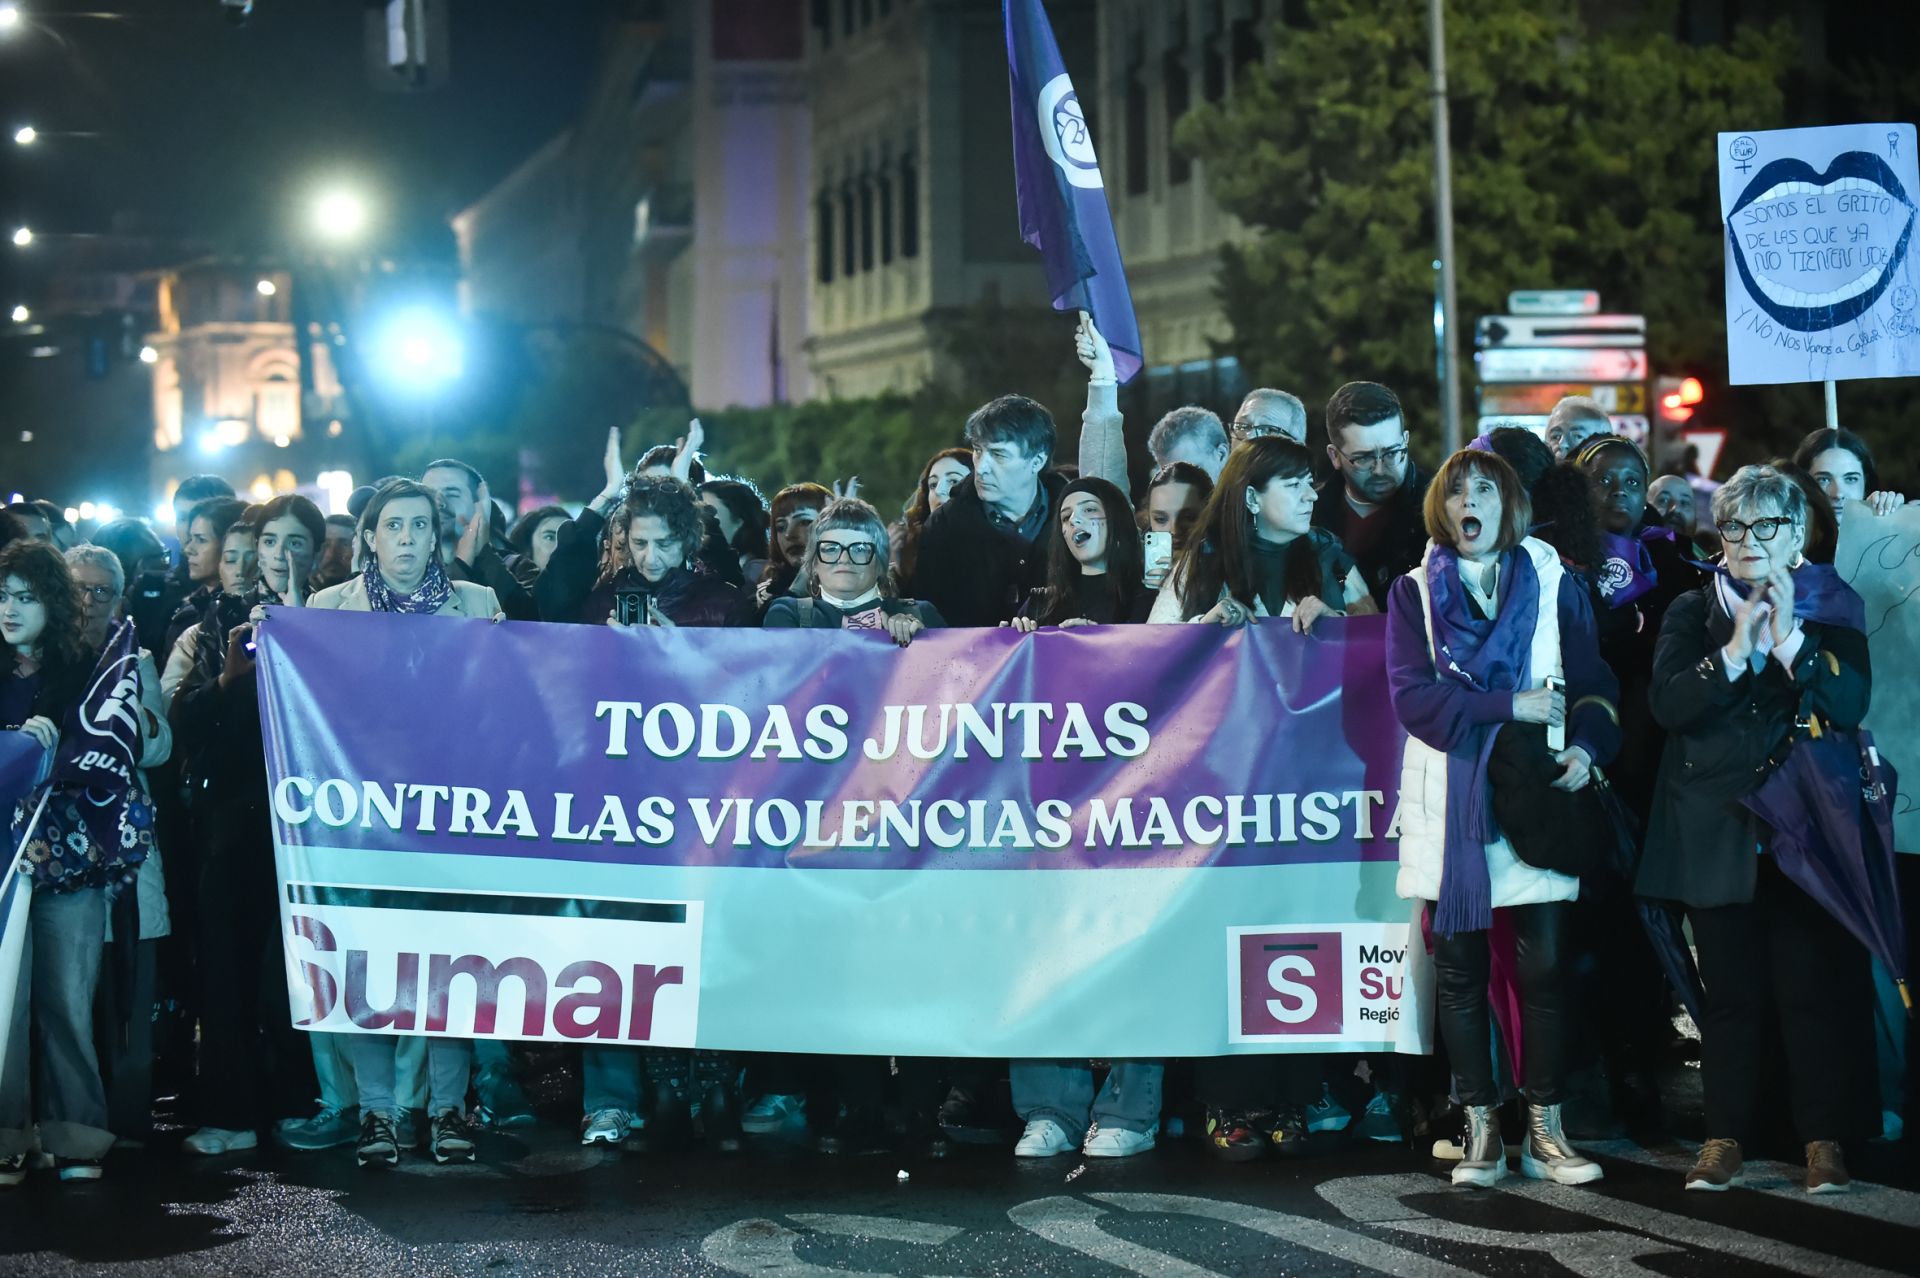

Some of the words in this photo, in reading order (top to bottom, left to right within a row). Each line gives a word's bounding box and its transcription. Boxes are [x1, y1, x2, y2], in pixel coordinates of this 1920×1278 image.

[1744, 201, 1798, 226] SOMOS
[1806, 197, 1826, 214] EL
[1838, 194, 1890, 215] GRITO
[1746, 232, 1770, 249] DE
[1774, 230, 1798, 245] LAS
[1804, 227, 1837, 244] QUE
[1755, 251, 1781, 272] NO
[1788, 247, 1853, 272] TIENEN
[1734, 304, 1752, 323] Y
[595, 700, 849, 760] TODAS
[863, 701, 1150, 760] JUNTAS
[274, 776, 539, 838] CONTRA
[552, 790, 675, 846] LAS
[687, 797, 1073, 850] VIOLENCIAS
[1266, 955, 1318, 1024] S
